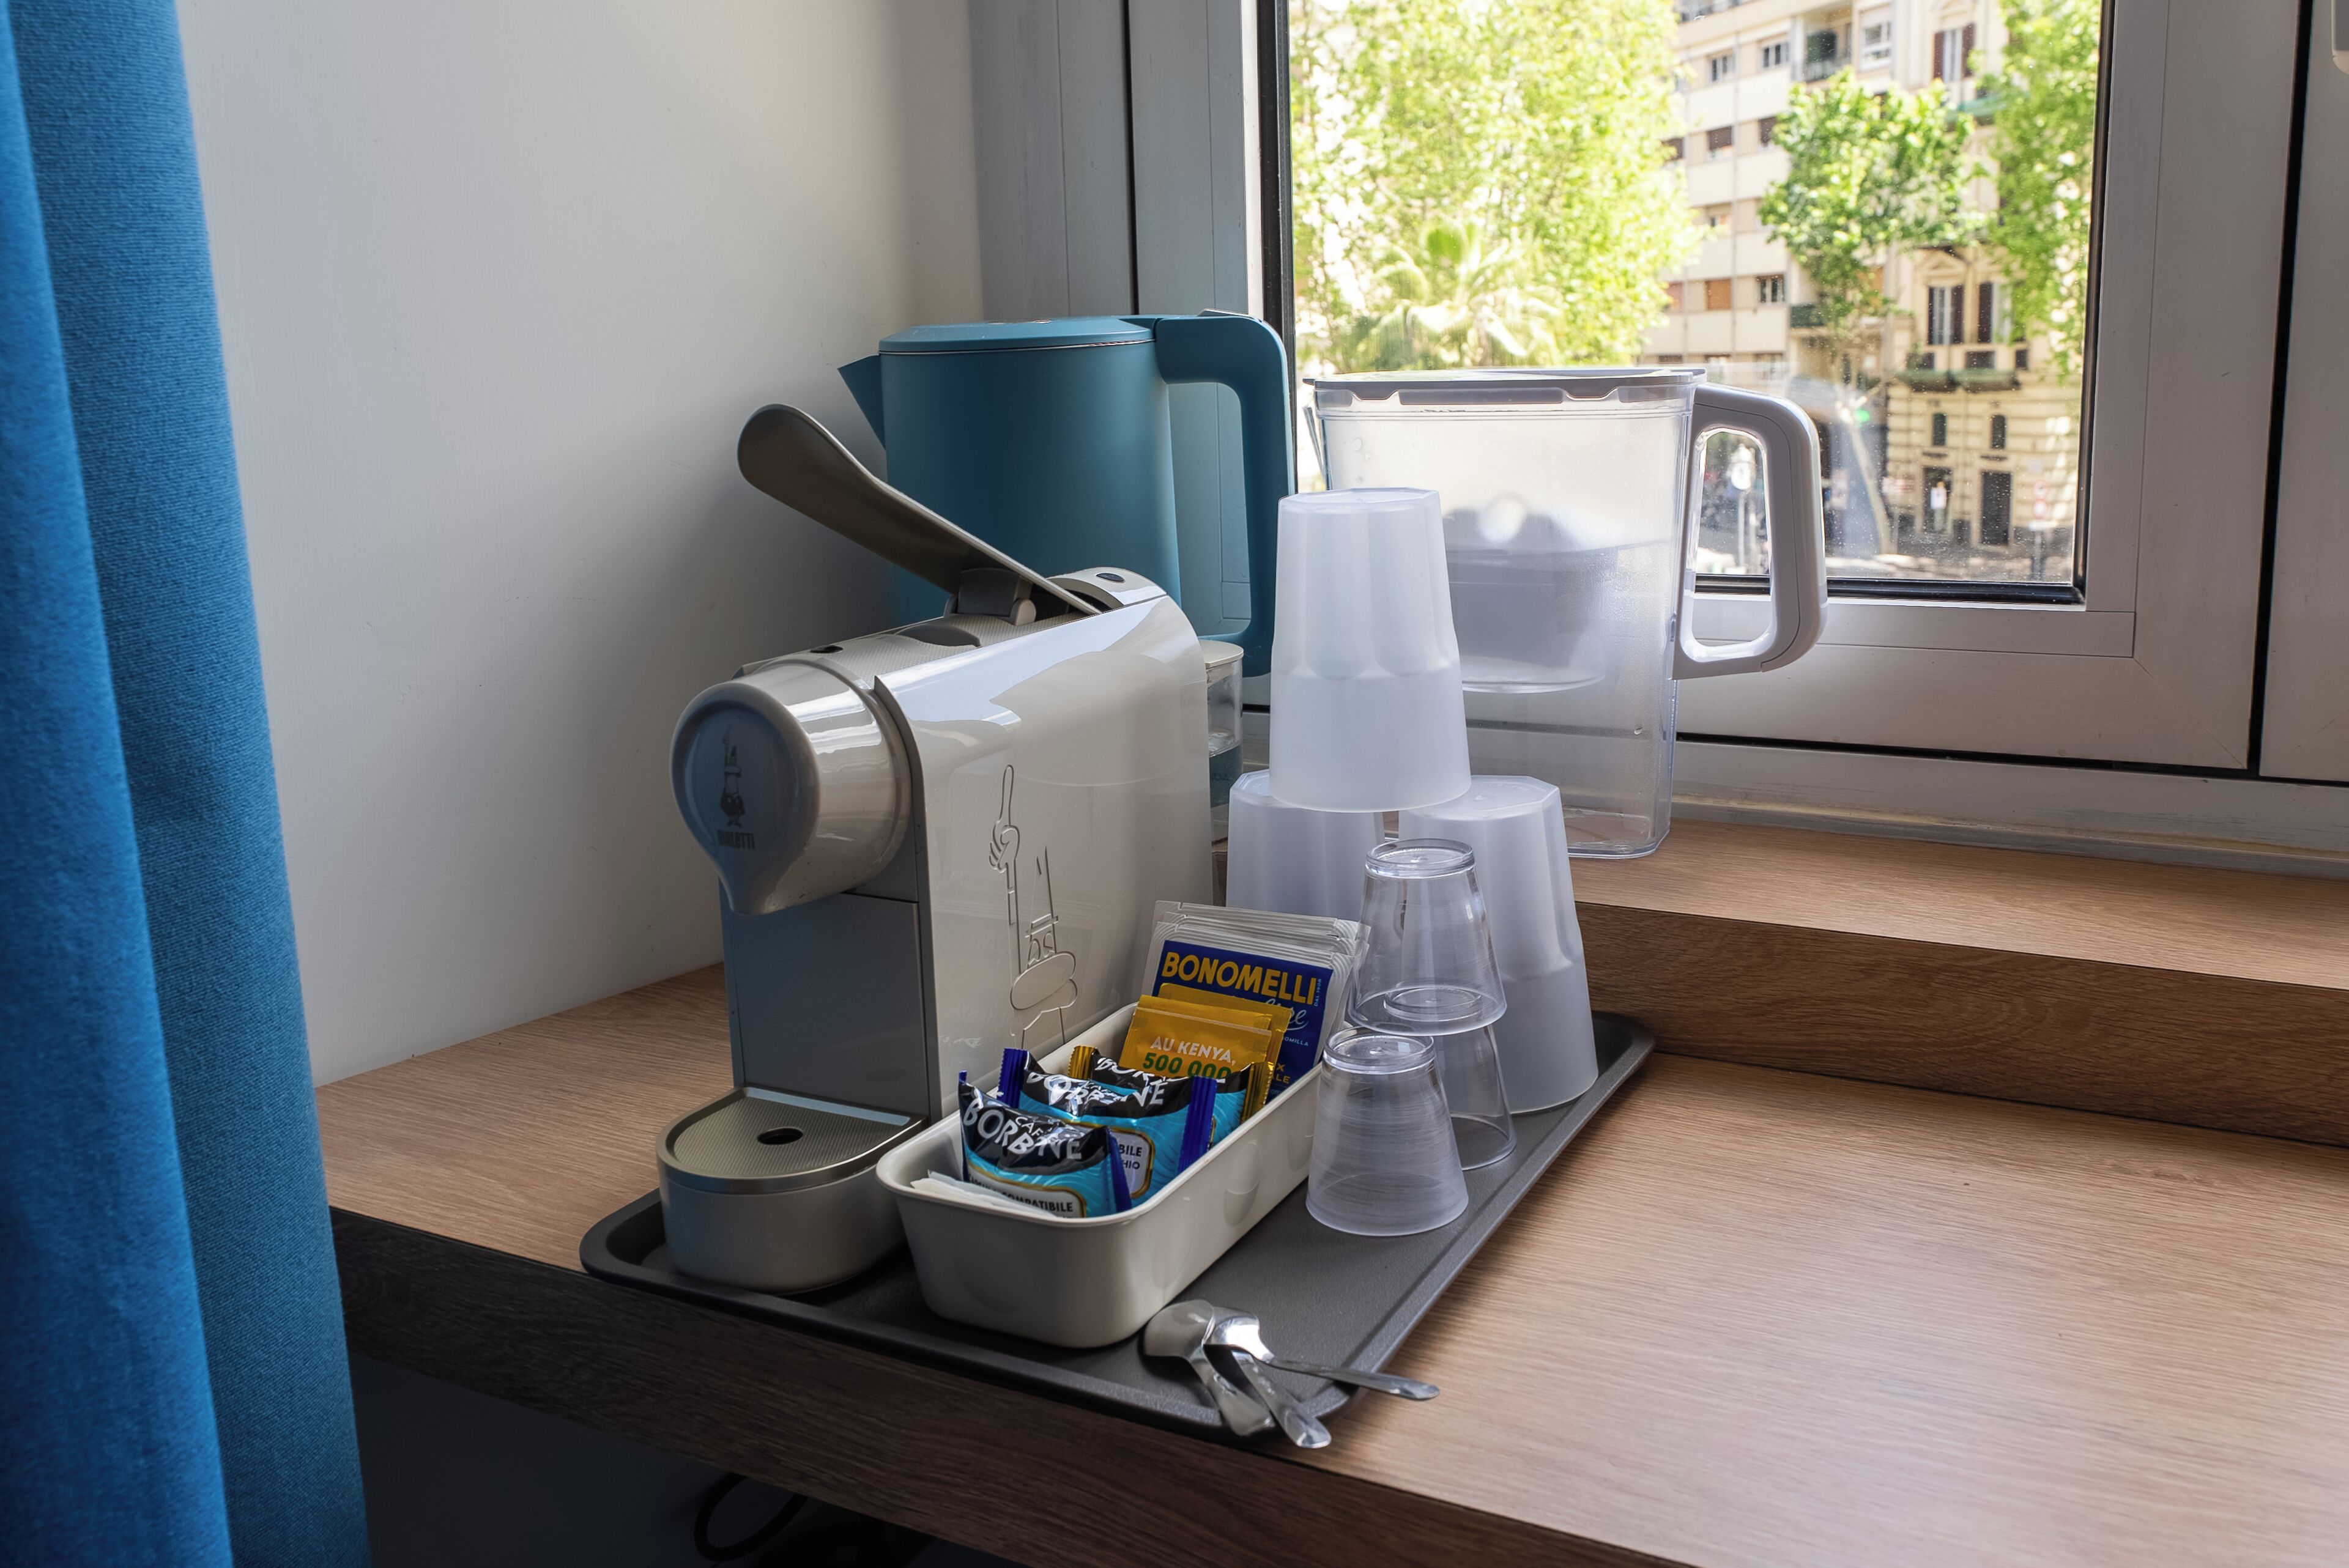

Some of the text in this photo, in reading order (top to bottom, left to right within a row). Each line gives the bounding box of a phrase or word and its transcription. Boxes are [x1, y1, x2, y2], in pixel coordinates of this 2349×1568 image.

[718, 829, 755, 849] BIALETTI
[1162, 952, 1316, 1005] BONOMELLI
[1150, 1036, 1236, 1065] AU KENYA,
[1284, 1037, 1308, 1046] OMILLA
[1143, 1052, 1182, 1074] 500
